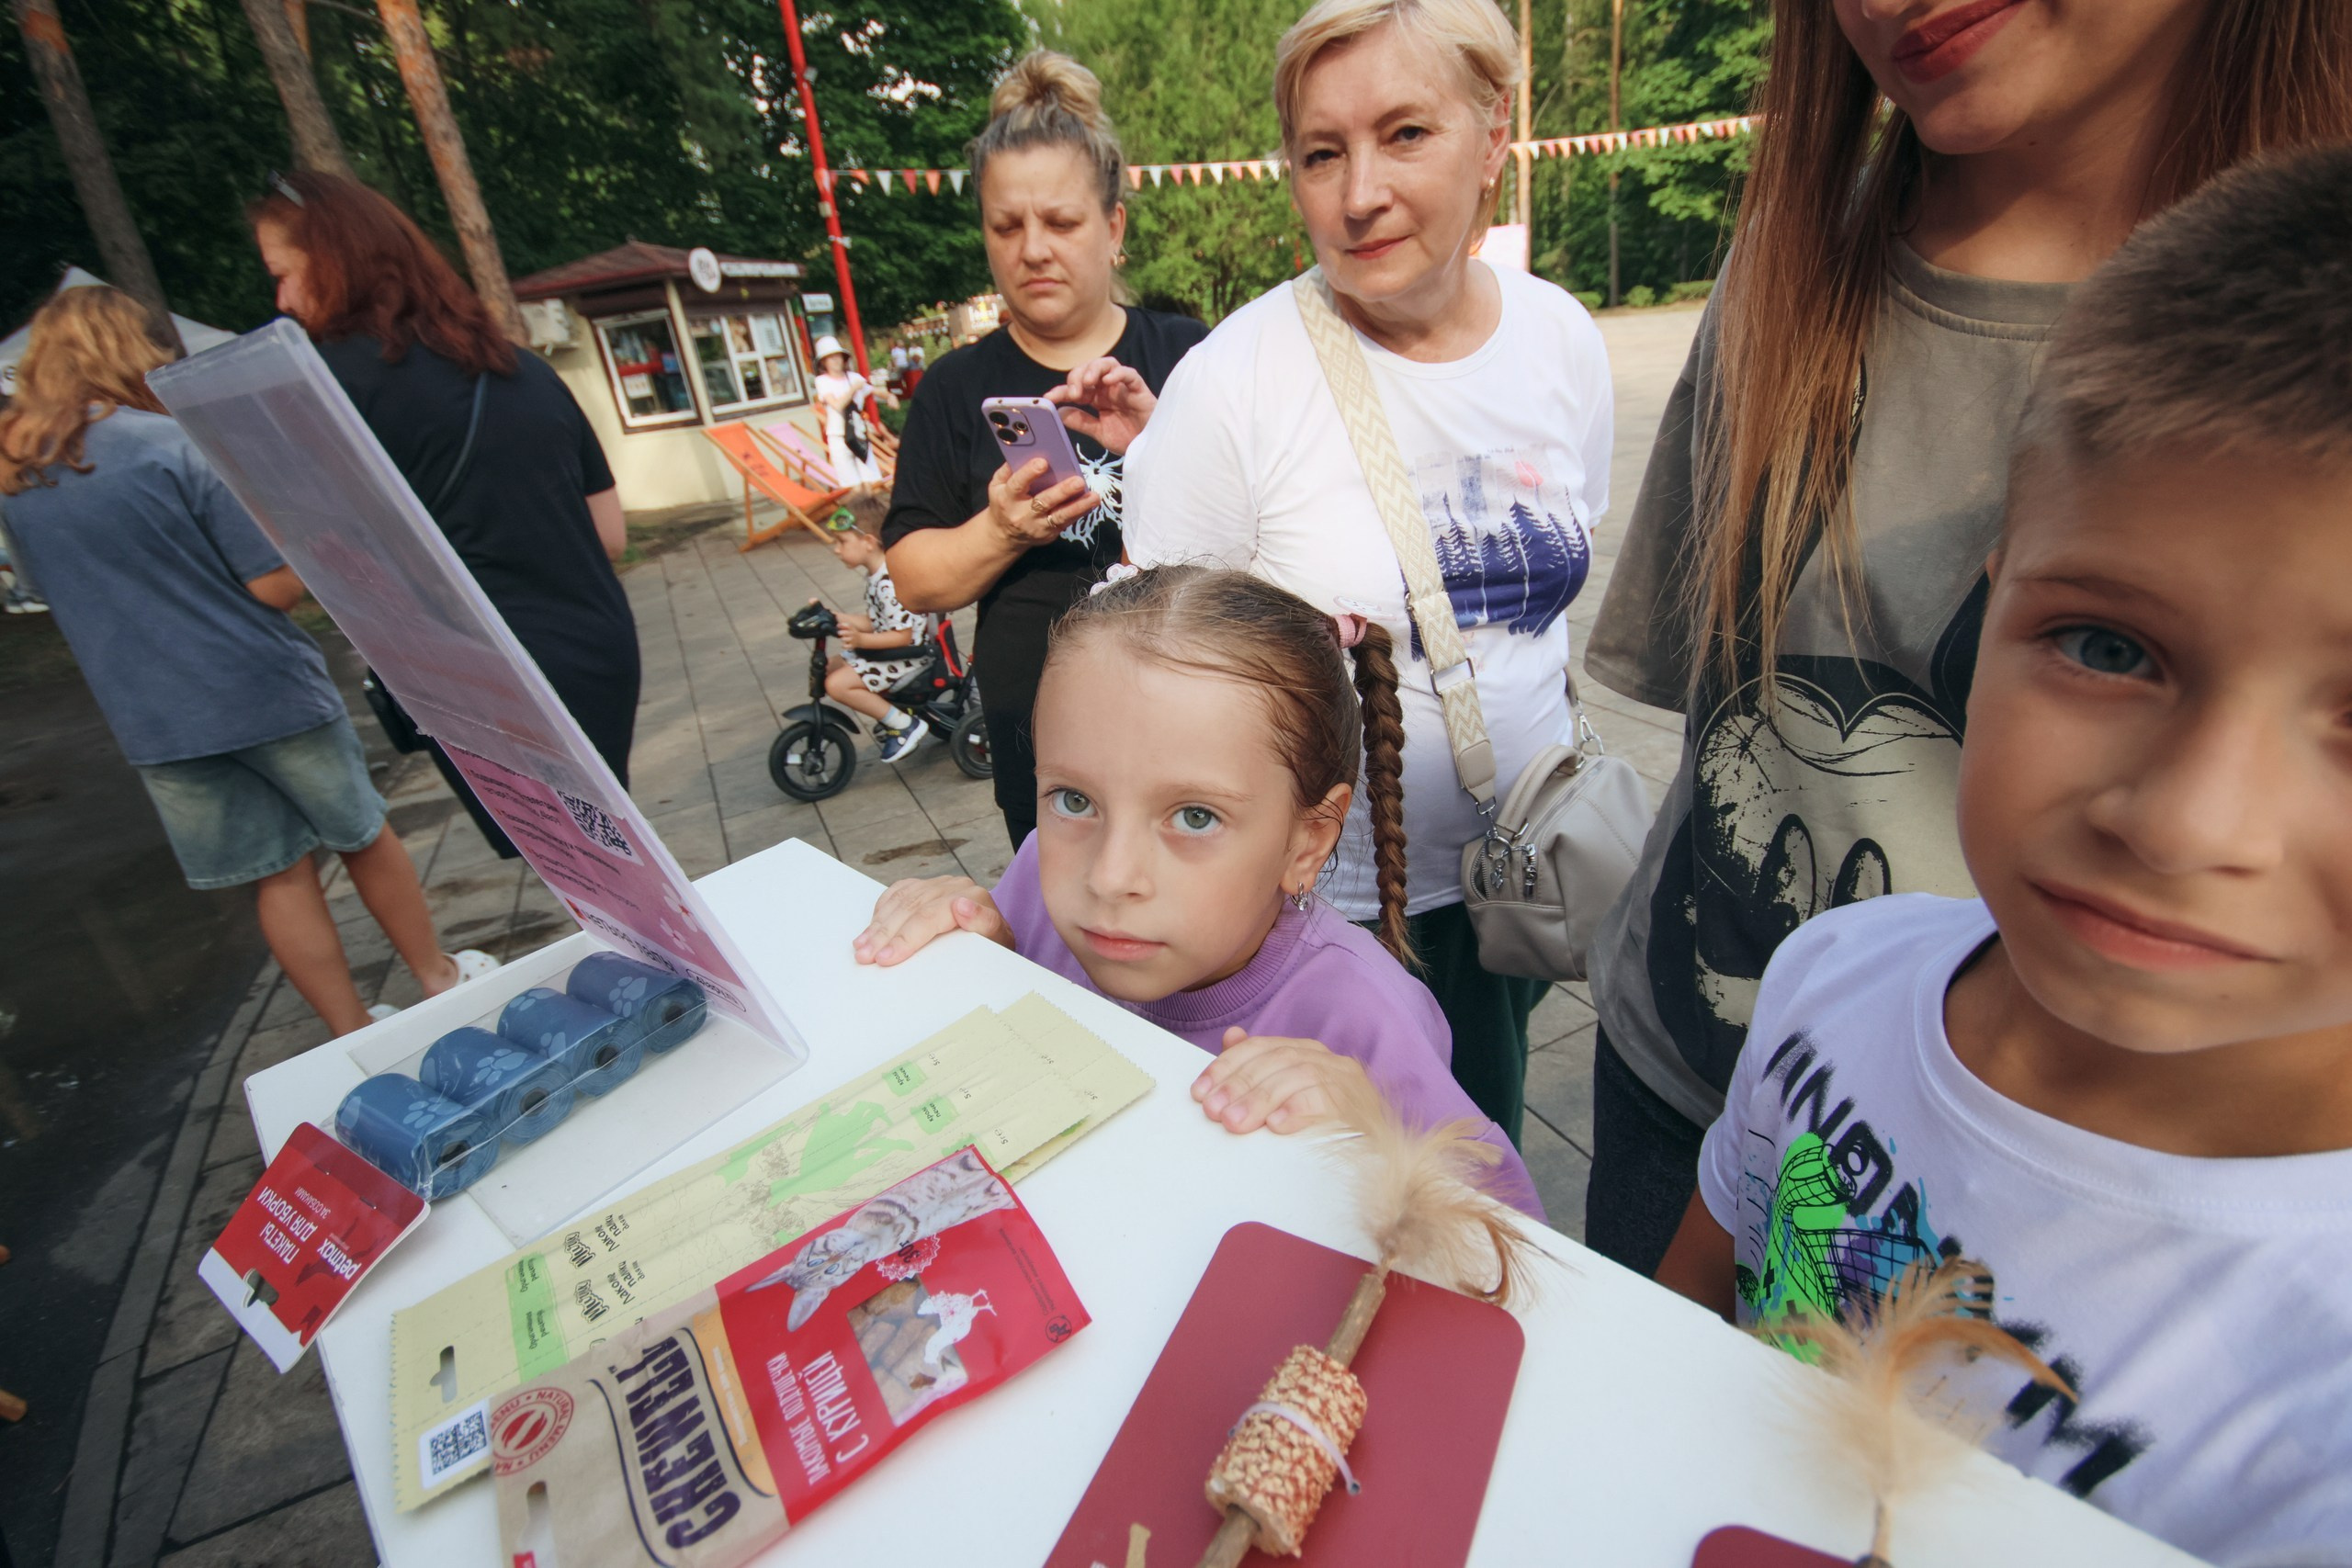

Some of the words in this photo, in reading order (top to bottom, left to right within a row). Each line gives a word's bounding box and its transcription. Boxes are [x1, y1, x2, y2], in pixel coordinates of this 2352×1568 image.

[257, 1186, 298, 1227] УБОРКИ
[294, 1186, 324, 1213] СОБАКАМИ
[320, 1204, 332, 1220] ЗА
[259, 1221, 300, 1265] ПАКЕТЫ
[289, 1213, 319, 1243] ДЛЯ
[316, 1238, 363, 1280] petmax
[536, 1390, 571, 1422] NATURAL
[765, 1351, 806, 1422] ПОДУШЕЧКИ
[797, 1349, 862, 1443] КУРИЦЕЙ
[789, 1416, 831, 1487] ЛАКОМЫЕ
[835, 1434, 869, 1463] С
